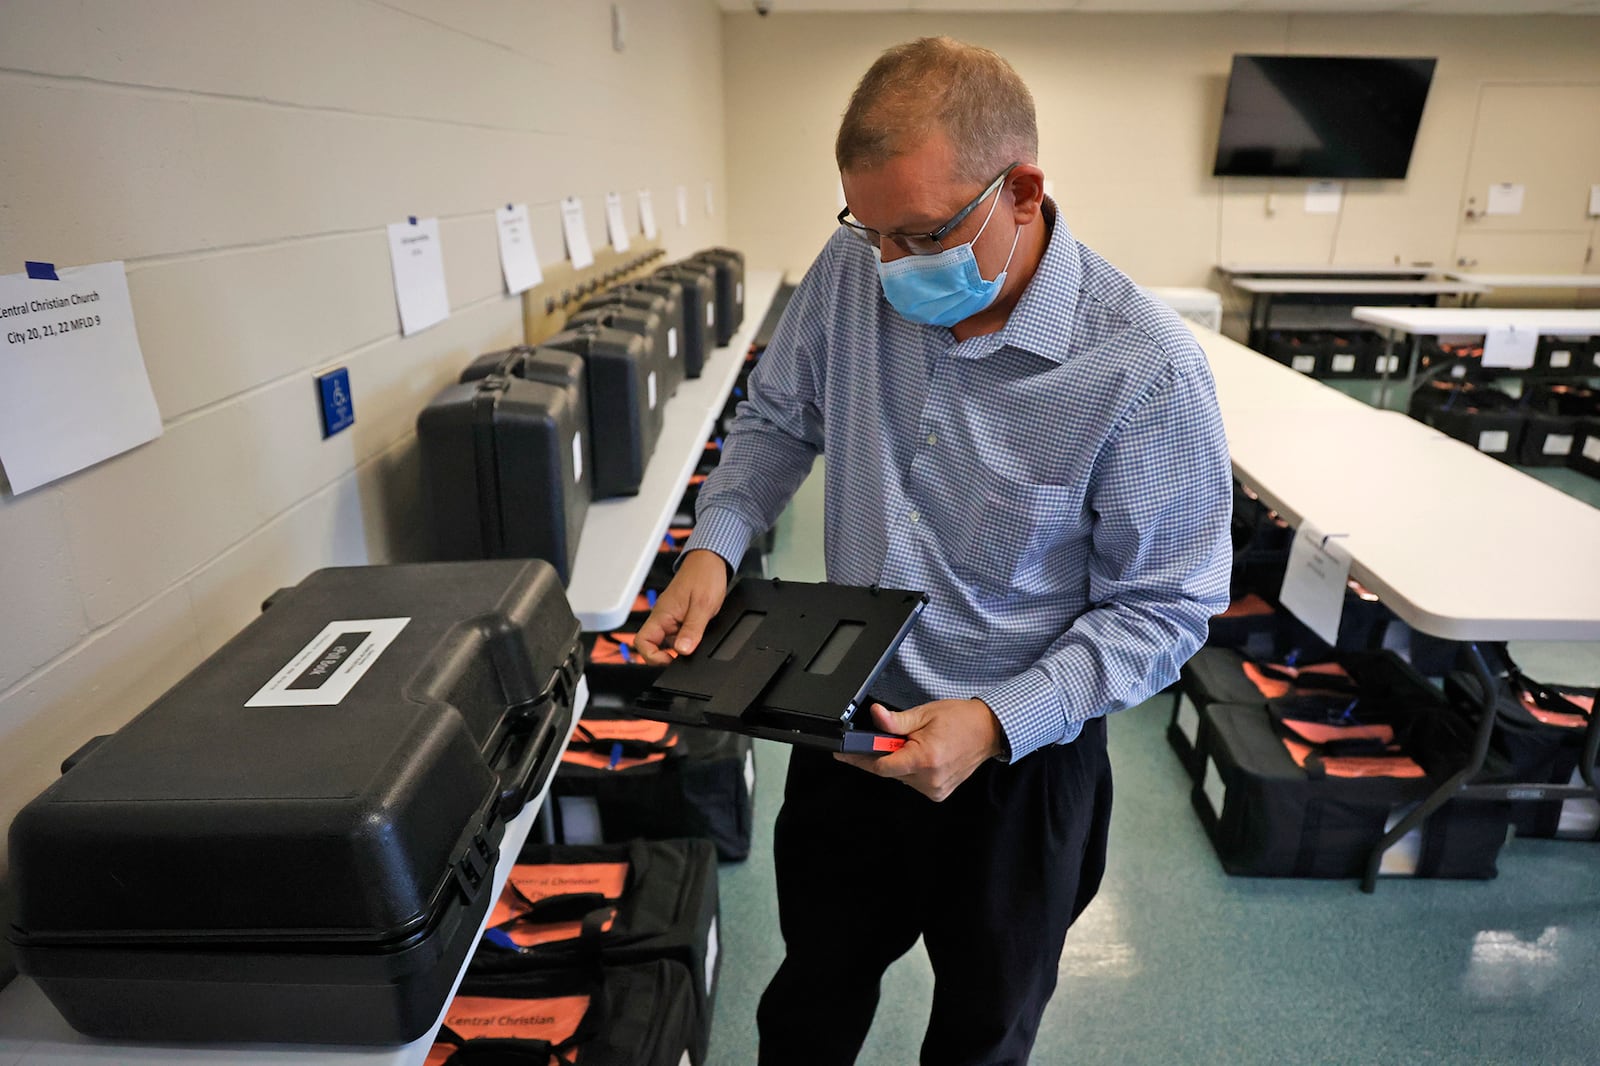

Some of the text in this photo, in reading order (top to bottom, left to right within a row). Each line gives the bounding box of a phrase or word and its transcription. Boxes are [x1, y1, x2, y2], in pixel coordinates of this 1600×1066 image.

[30, 297, 70, 312] Christian
[71, 291, 100, 305] Church
[8, 315, 101, 344] City 20, 21, 22 MFLD 9
[448, 1014, 556, 1027] Central Christian
